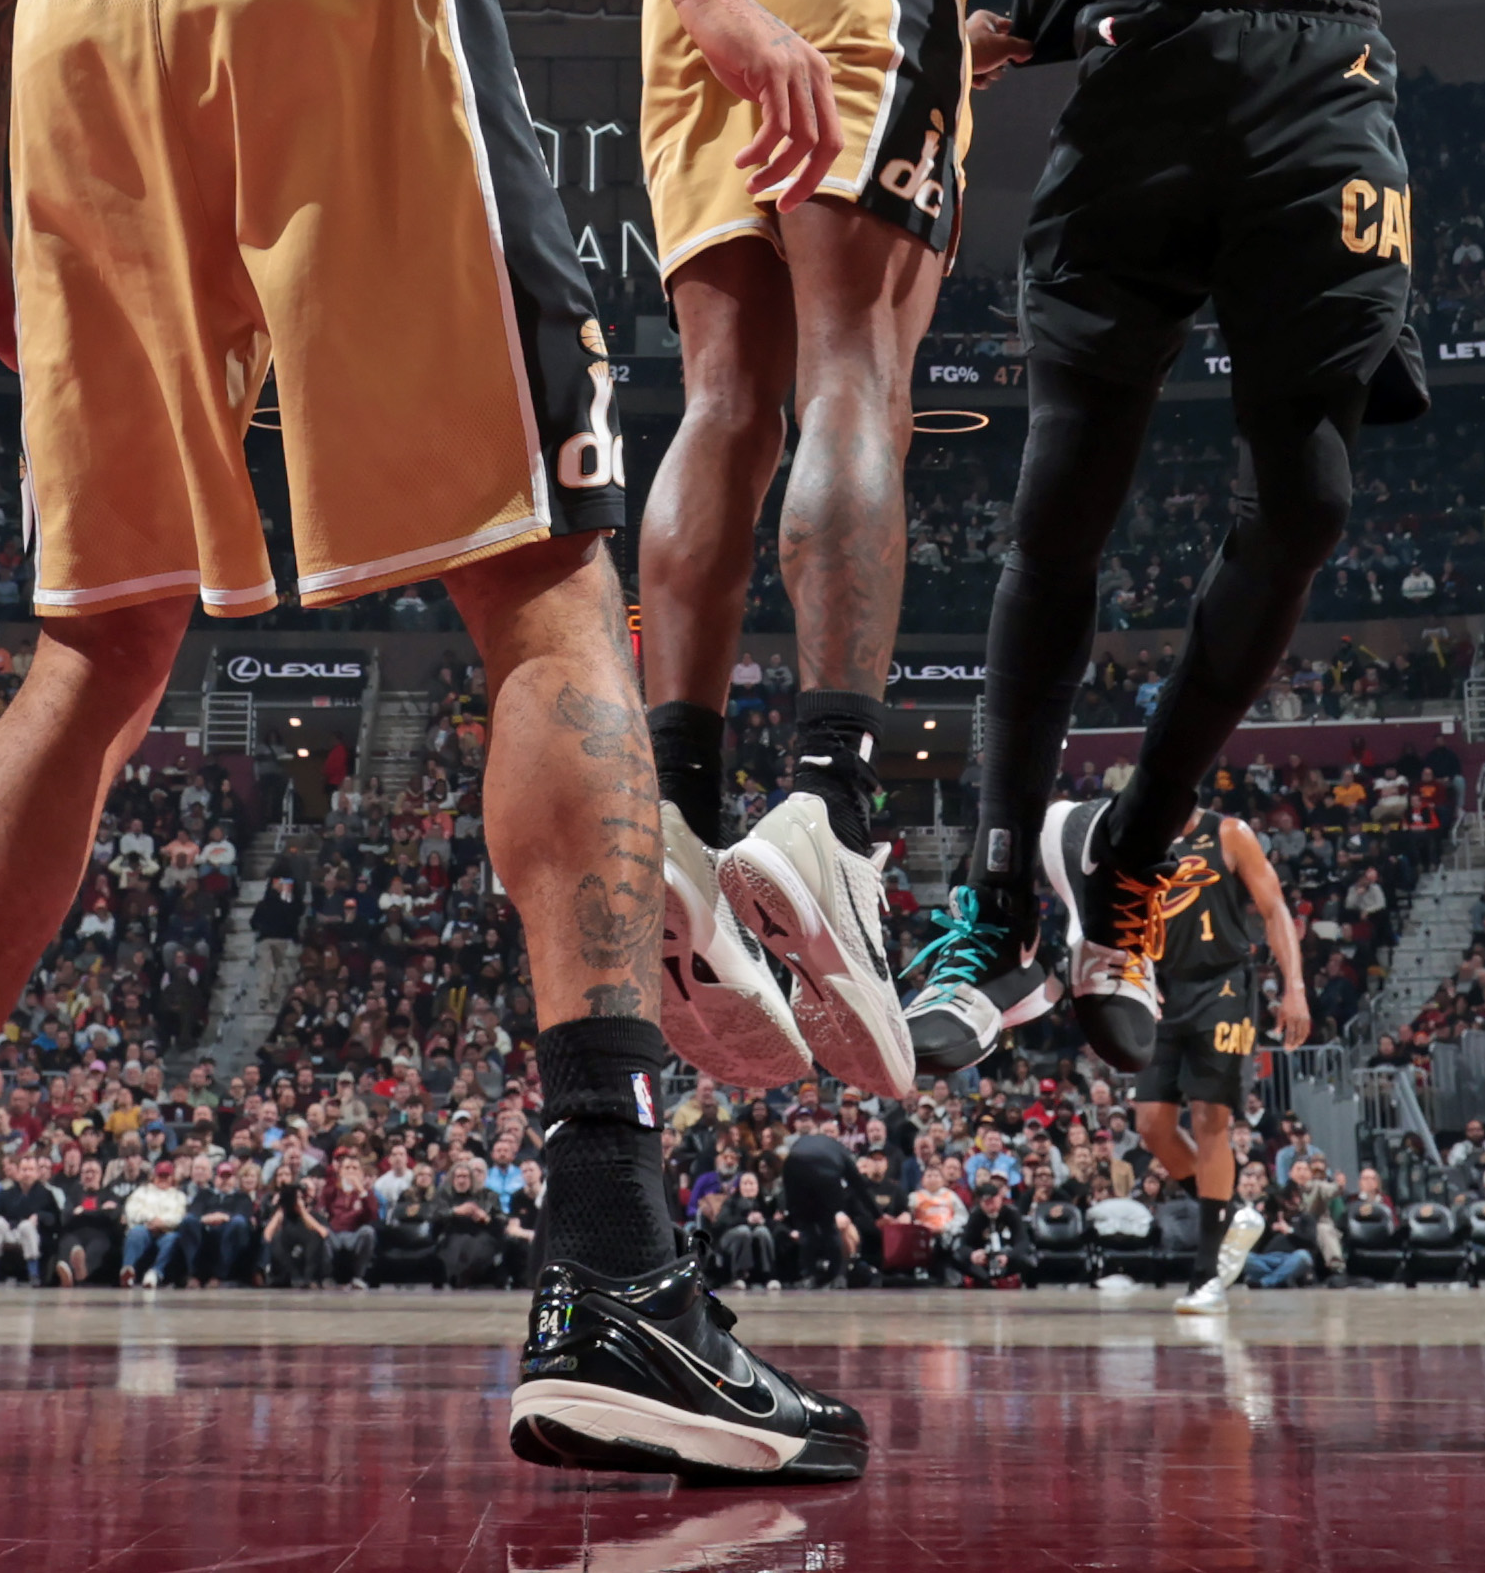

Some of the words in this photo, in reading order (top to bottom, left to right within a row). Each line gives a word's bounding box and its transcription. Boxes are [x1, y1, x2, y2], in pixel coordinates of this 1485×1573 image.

[930, 364, 979, 383] FG%
[994, 365, 1023, 386] 47
[264, 661, 362, 679] LEXUS
[1199, 909, 1215, 942] 1
[538, 1309, 560, 1335] 24
